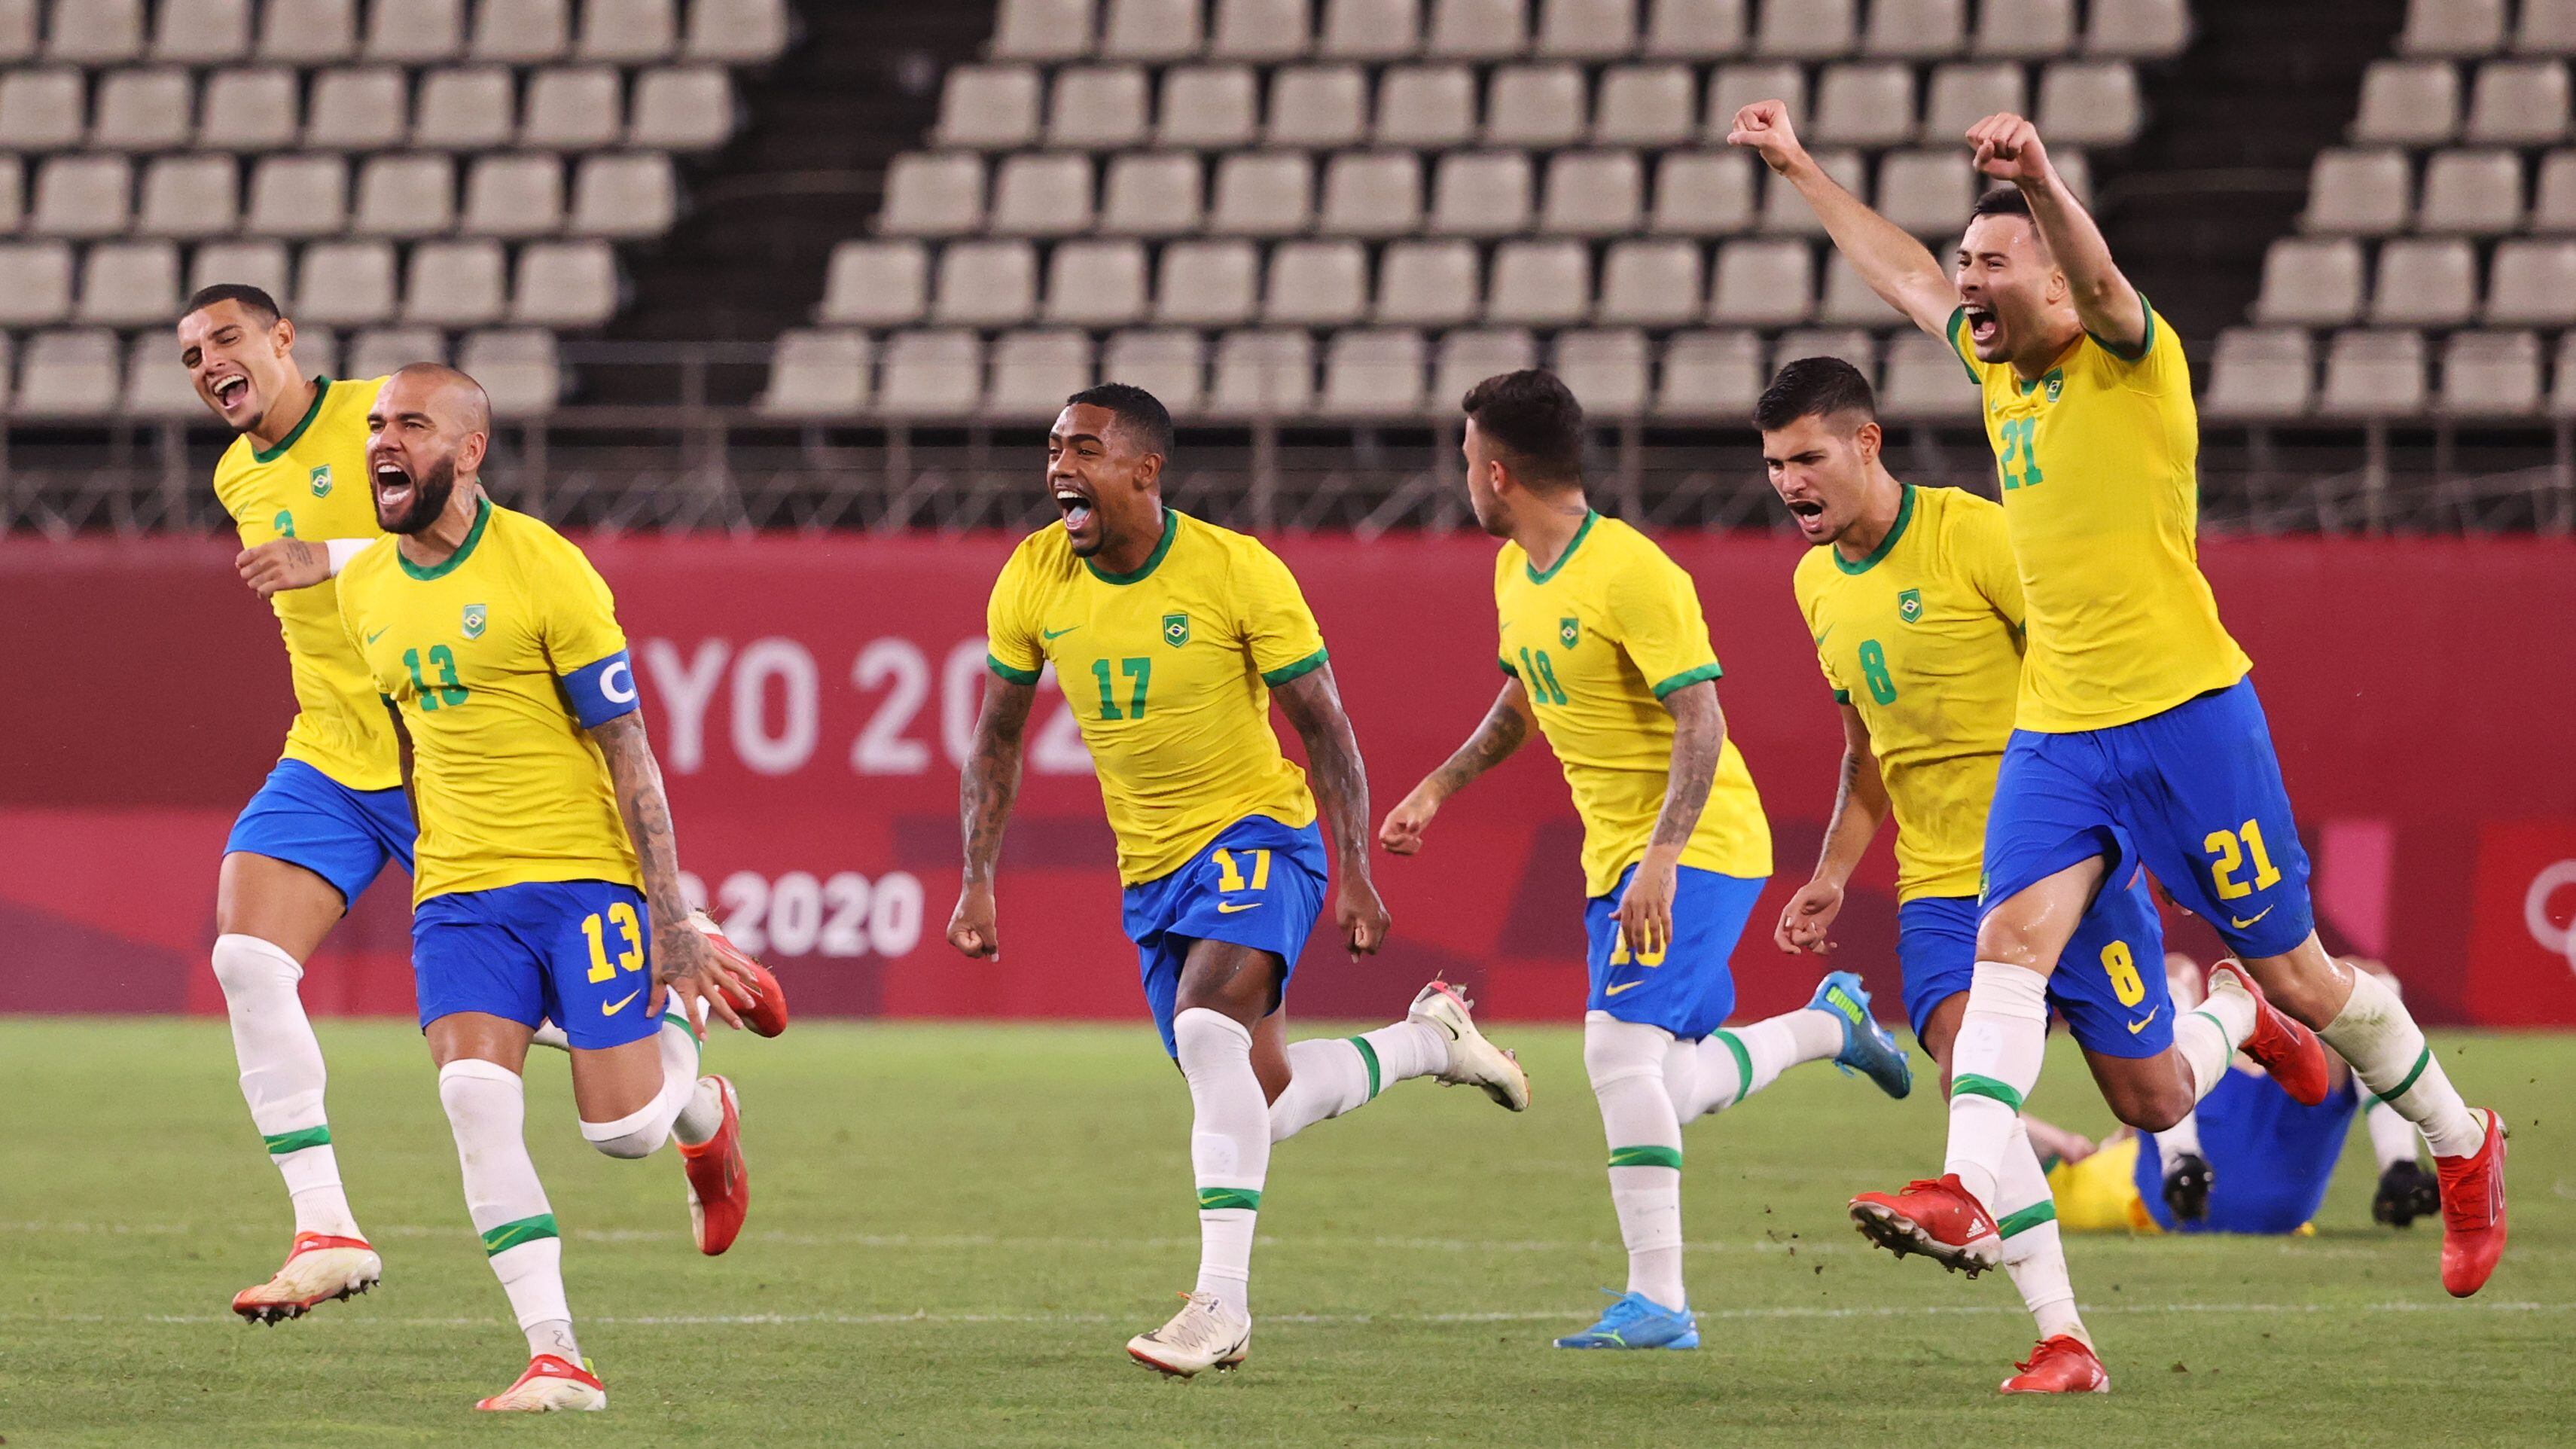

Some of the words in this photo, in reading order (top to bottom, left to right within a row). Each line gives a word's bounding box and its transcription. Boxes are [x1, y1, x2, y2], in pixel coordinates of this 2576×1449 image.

[2001, 417, 2043, 490] 21
[403, 645, 468, 711] 13
[600, 662, 635, 703] C
[642, 637, 820, 775] YO
[1092, 657, 1151, 719] 17
[1859, 639, 1897, 706] 8
[1212, 848, 1270, 892] 17
[2203, 818, 2282, 900] 21
[581, 902, 645, 984] 13
[718, 870, 925, 957] 2020
[2099, 940, 2145, 1008] 8
